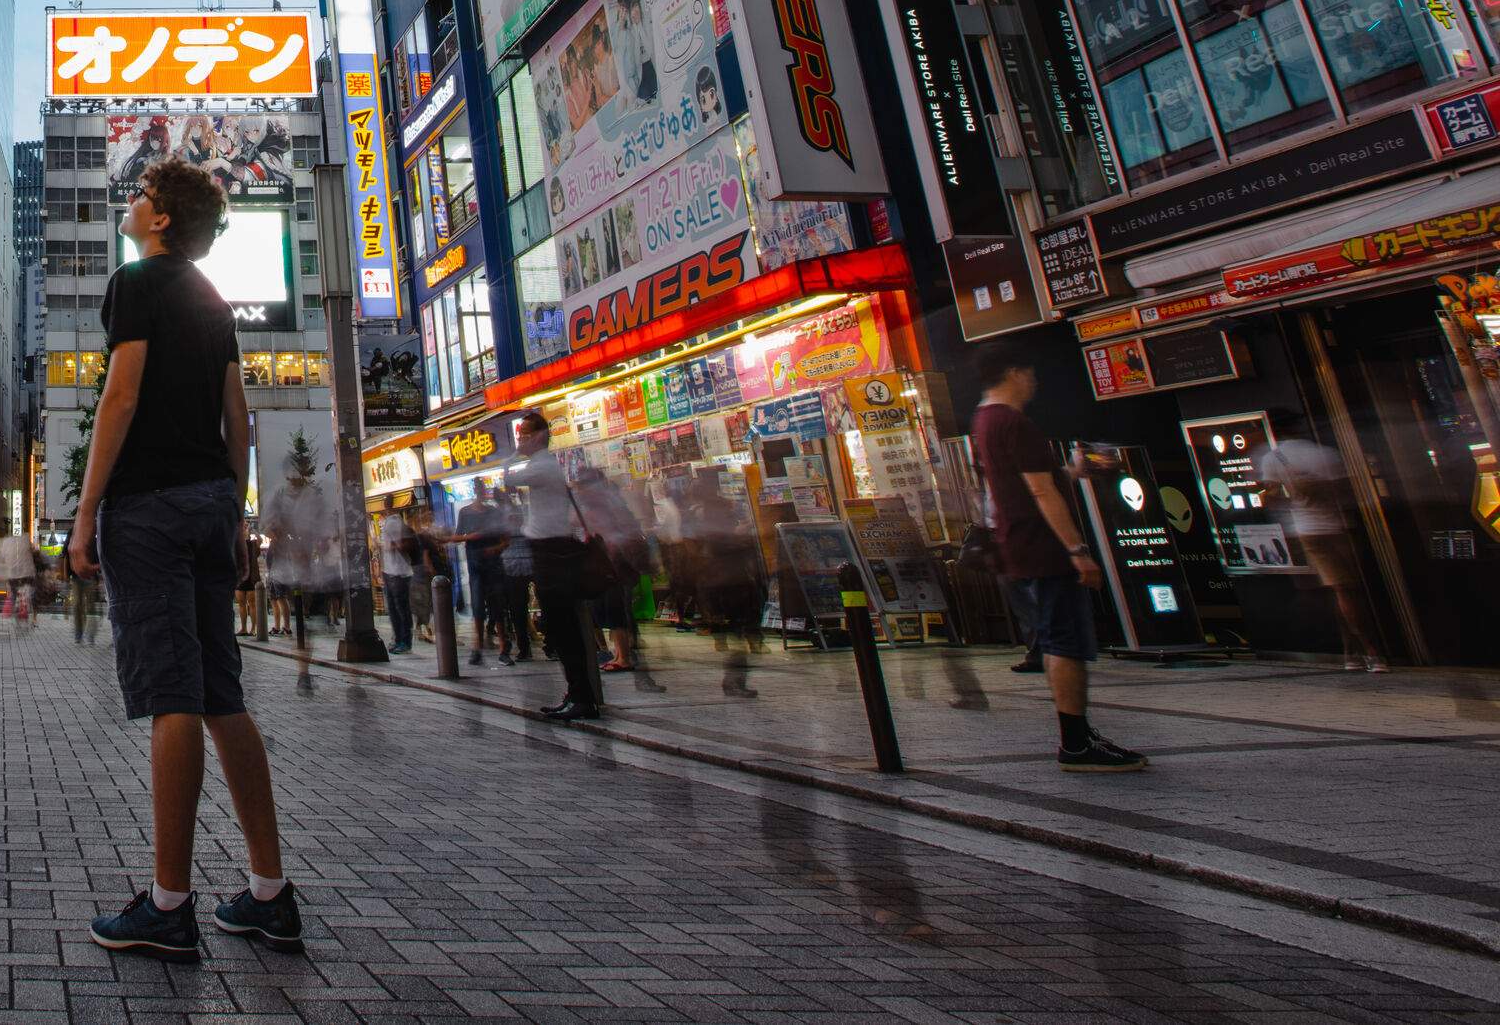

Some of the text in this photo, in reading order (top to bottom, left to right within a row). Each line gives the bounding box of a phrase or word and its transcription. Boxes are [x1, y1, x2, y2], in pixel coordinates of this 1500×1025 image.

[57, 18, 305, 85] オノデン
[906, 8, 928, 48] AKIBA
[346, 72, 373, 97] 薬
[928, 97, 959, 186] ALIENWARE
[1109, 201, 1187, 237] ALIENWARE
[1188, 186, 1236, 215] STORE
[1240, 171, 1289, 196] AKIBA
[1308, 157, 1337, 175] Dell
[1338, 146, 1372, 165] Real
[1373, 135, 1406, 155] Site
[646, 189, 722, 254] ON SALE
[566, 228, 751, 355] GAMERS
[1116, 527, 1166, 537] ALIENWARE
[1118, 539, 1148, 547] STORE
[1127, 559, 1145, 567] Dell
[1145, 559, 1161, 567] Real
